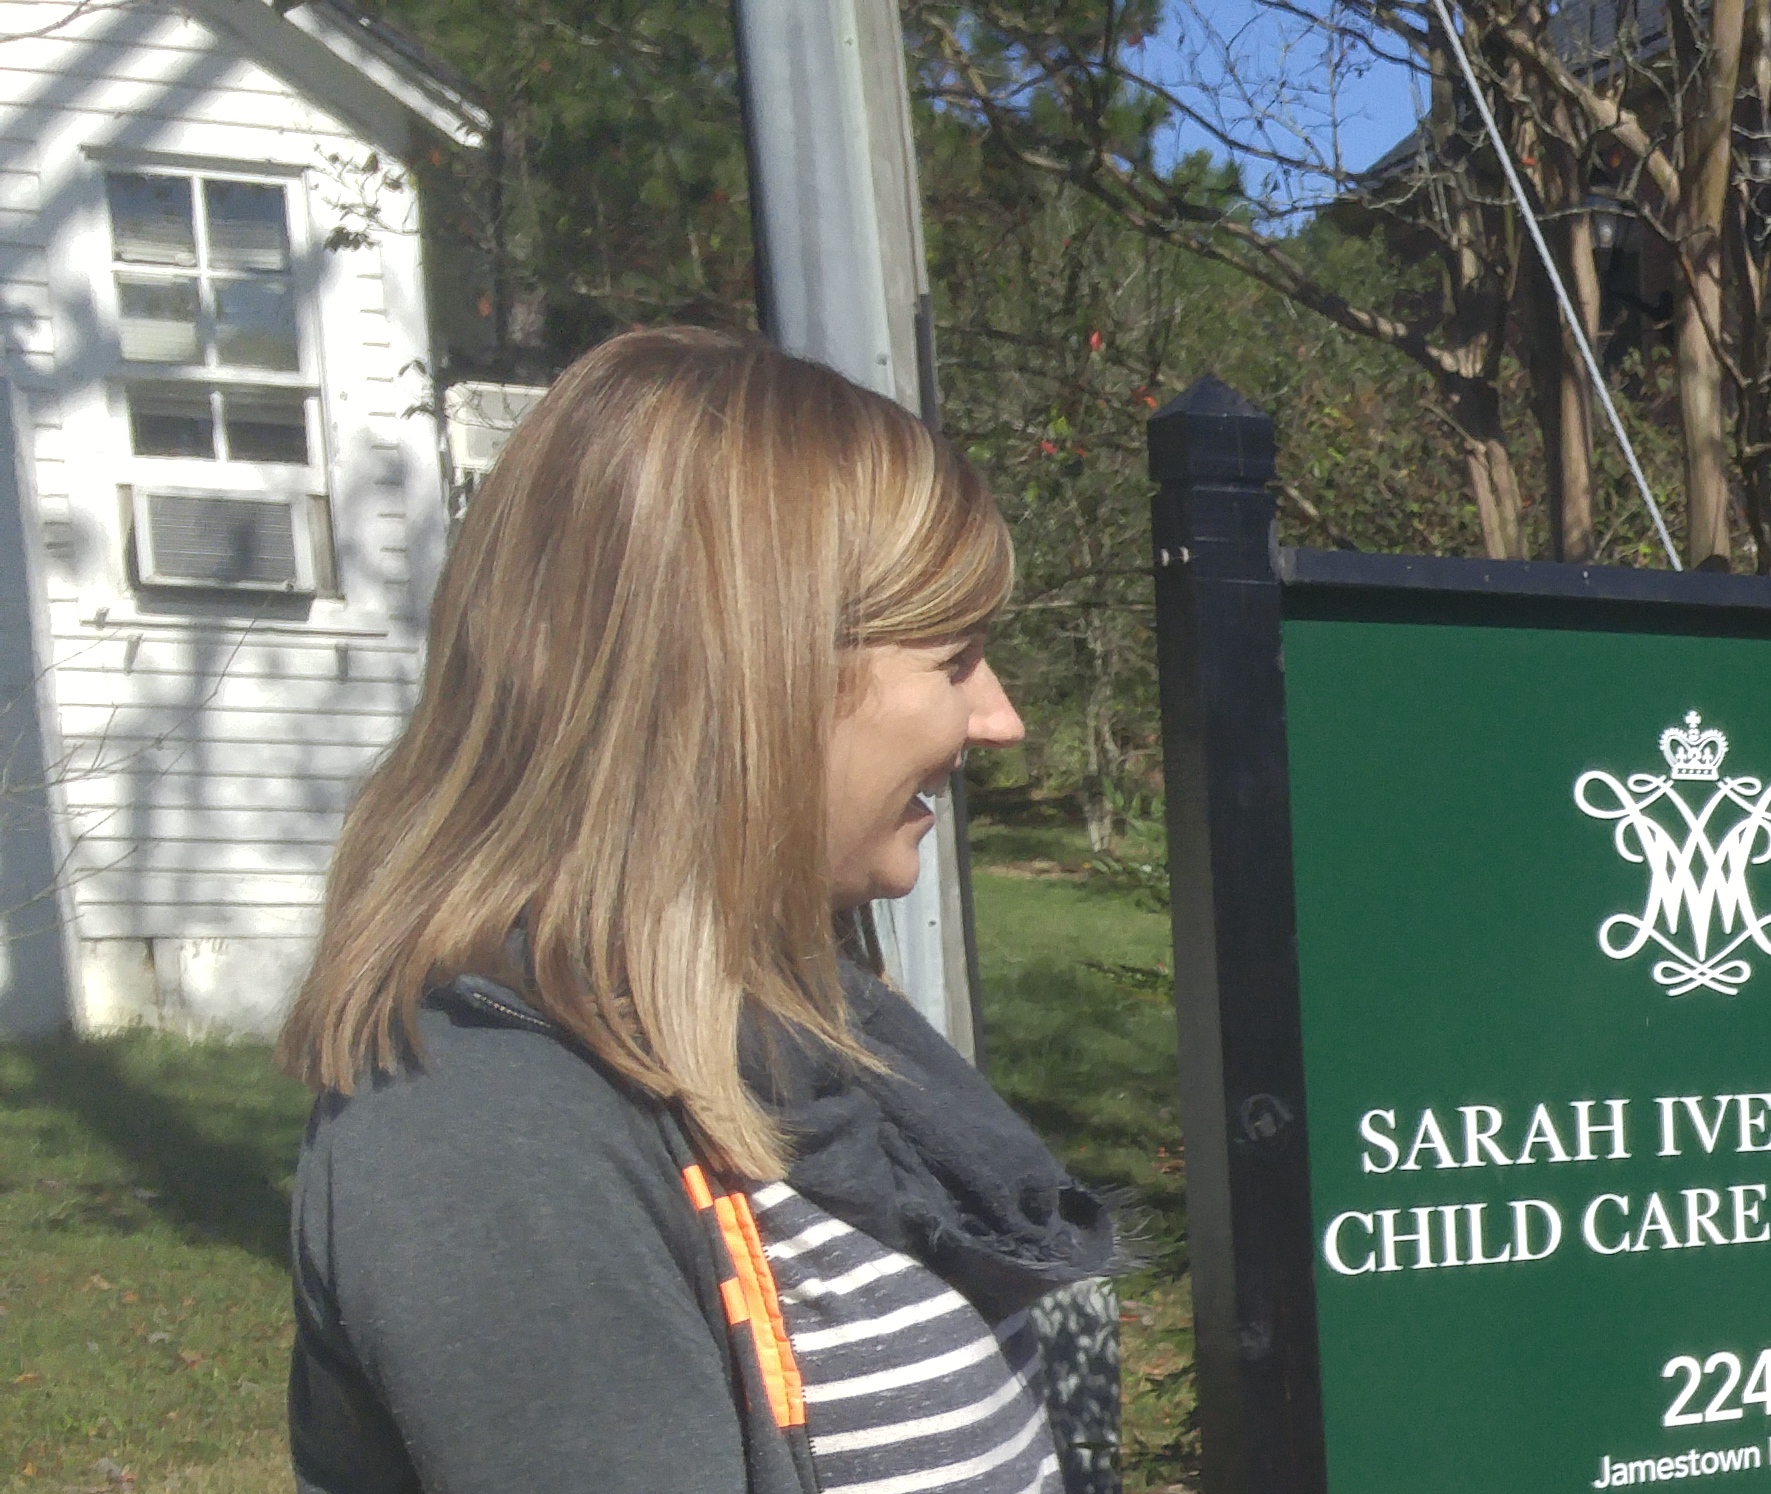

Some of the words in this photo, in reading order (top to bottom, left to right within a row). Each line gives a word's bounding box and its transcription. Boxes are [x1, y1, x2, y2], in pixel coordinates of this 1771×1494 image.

[1359, 1099, 1632, 1174] SARAH
[1323, 1200, 1562, 1276] CHILD
[1583, 1183, 1771, 1255] CARE
[1592, 1443, 1762, 1489] Jamestown
